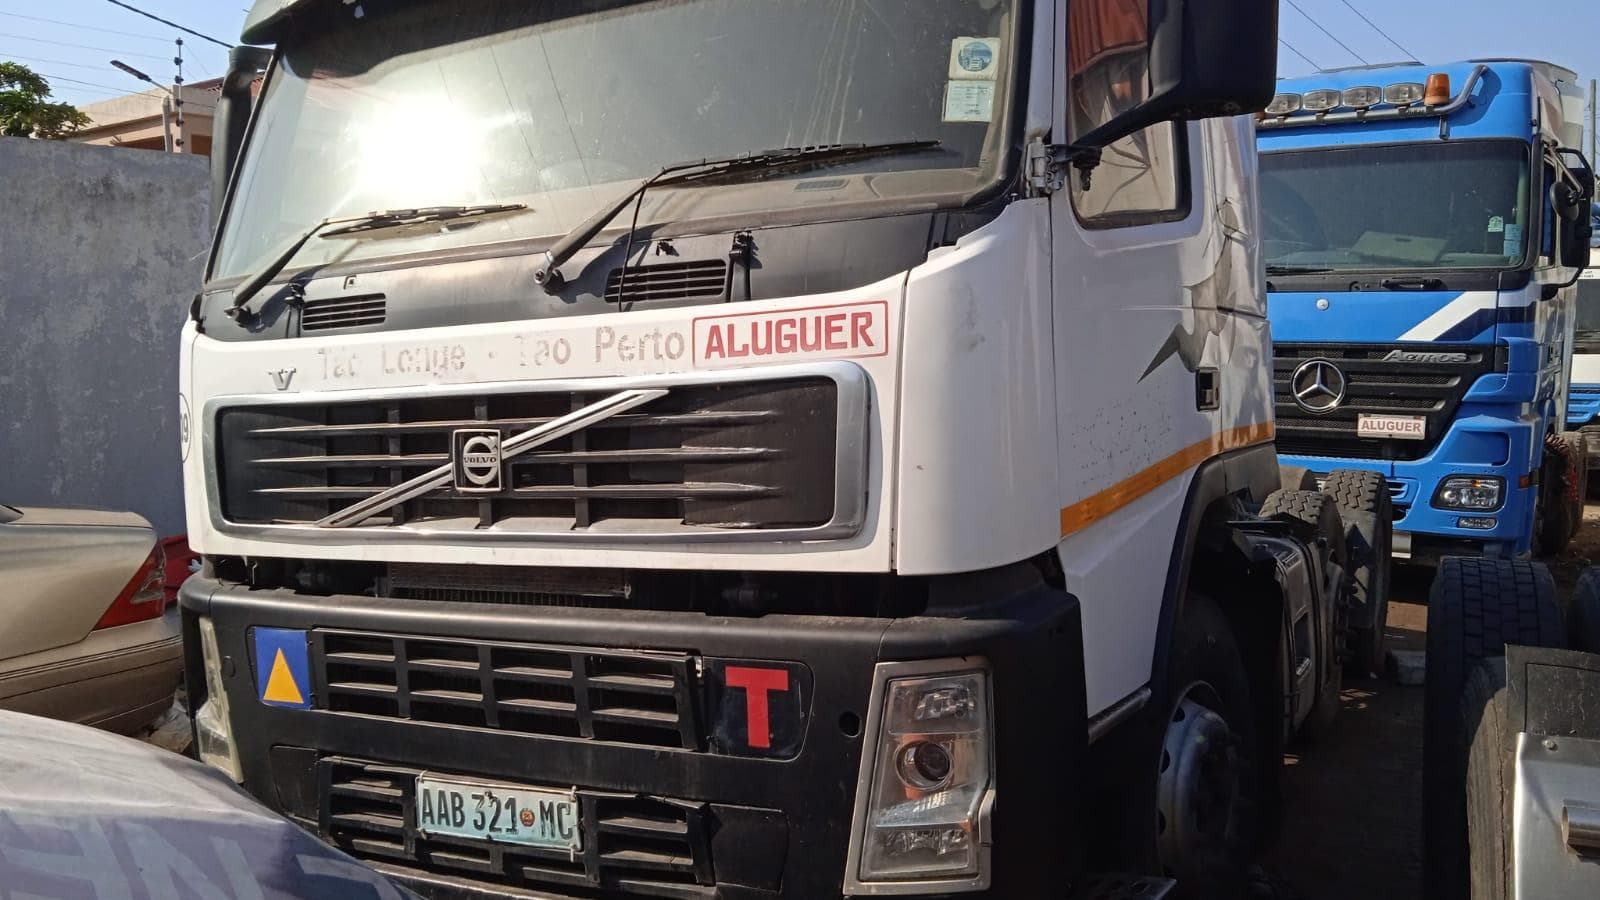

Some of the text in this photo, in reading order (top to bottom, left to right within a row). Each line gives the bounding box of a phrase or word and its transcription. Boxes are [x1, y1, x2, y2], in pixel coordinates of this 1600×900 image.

[595, 325, 686, 363] Perto
[705, 311, 874, 359] ALUGUER
[1360, 418, 1423, 433] ALUGUER
[463, 456, 497, 464] VOLVO
[725, 665, 789, 749] T
[422, 788, 574, 841] AAB 321 MC
